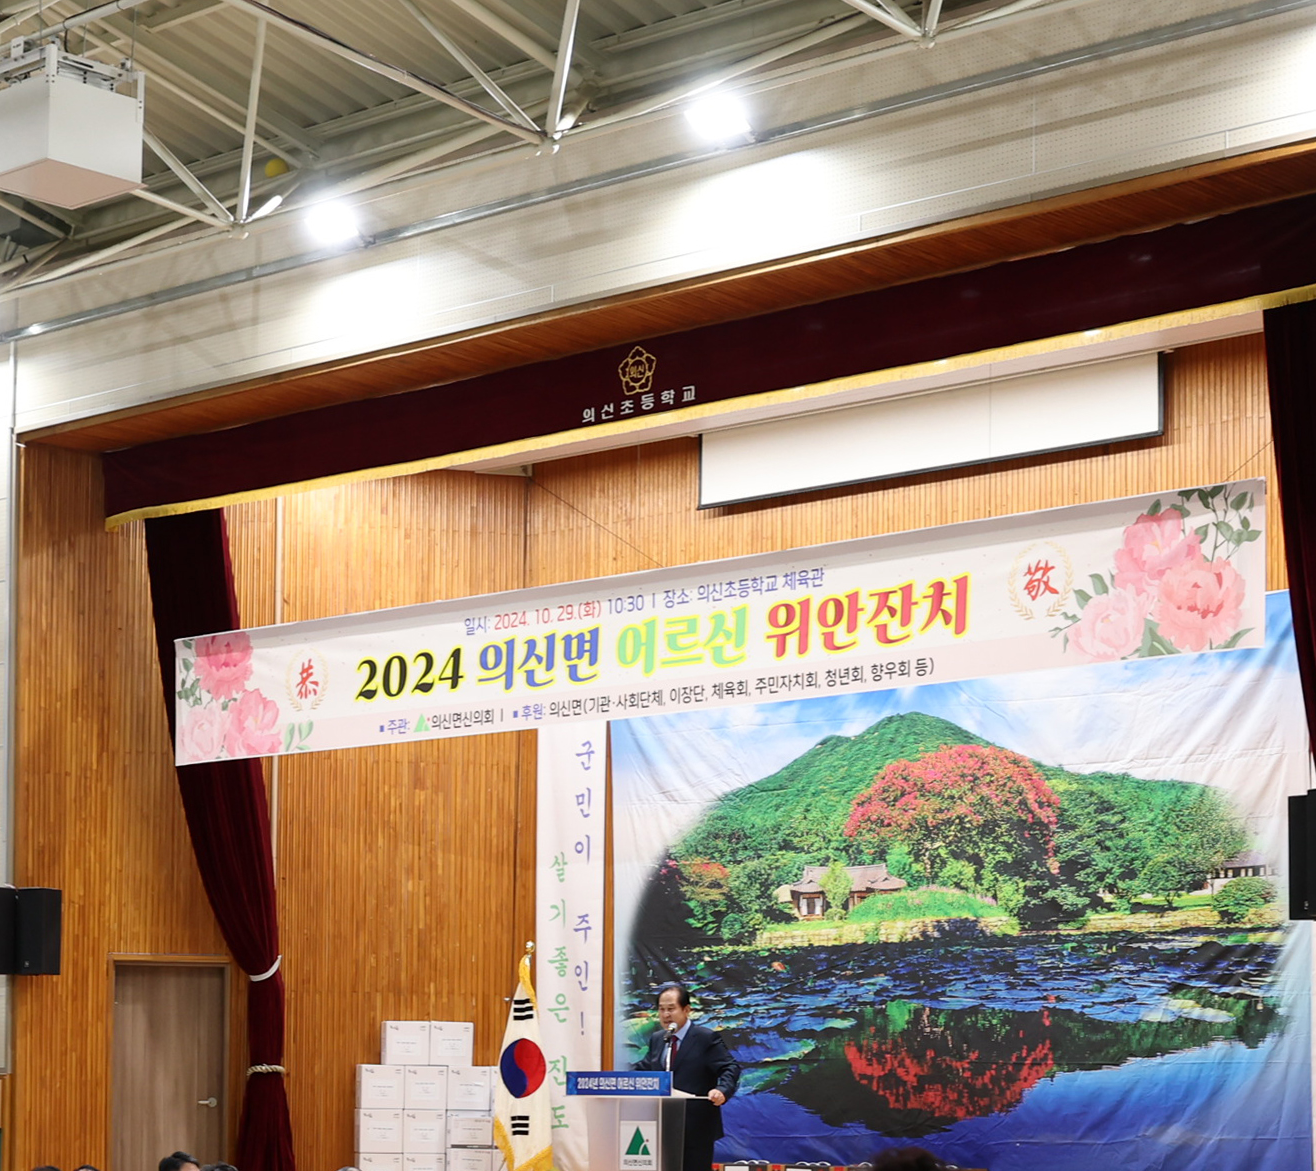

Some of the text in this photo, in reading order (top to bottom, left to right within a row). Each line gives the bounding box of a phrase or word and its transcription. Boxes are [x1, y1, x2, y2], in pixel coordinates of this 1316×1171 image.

[582, 385, 696, 423] 의신초등학교
[355, 574, 971, 702] 2024 의신면 어르신 위안잔치
[464, 616, 491, 635] 일시:
[494, 609, 530, 630] 2024.
[535, 606, 555, 624] 10.
[607, 593, 645, 614] 10:30
[663, 588, 694, 608] 장소:
[697, 574, 779, 602] 의신초등학교
[782, 568, 825, 589] 체육관
[387, 718, 411, 736] 주관:
[431, 708, 495, 730] 의신면신의회
[521, 704, 546, 722] 후원:
[669, 684, 709, 704] 이장단,
[711, 676, 752, 698] 체육회,
[754, 668, 823, 696] 주민자치회,
[824, 660, 868, 688] 청년회,
[870, 658, 912, 684] 향우회
[914, 656, 936, 678] 등)
[573, 738, 597, 1037] 군민이 주인!
[547, 1055, 571, 1131] 진도
